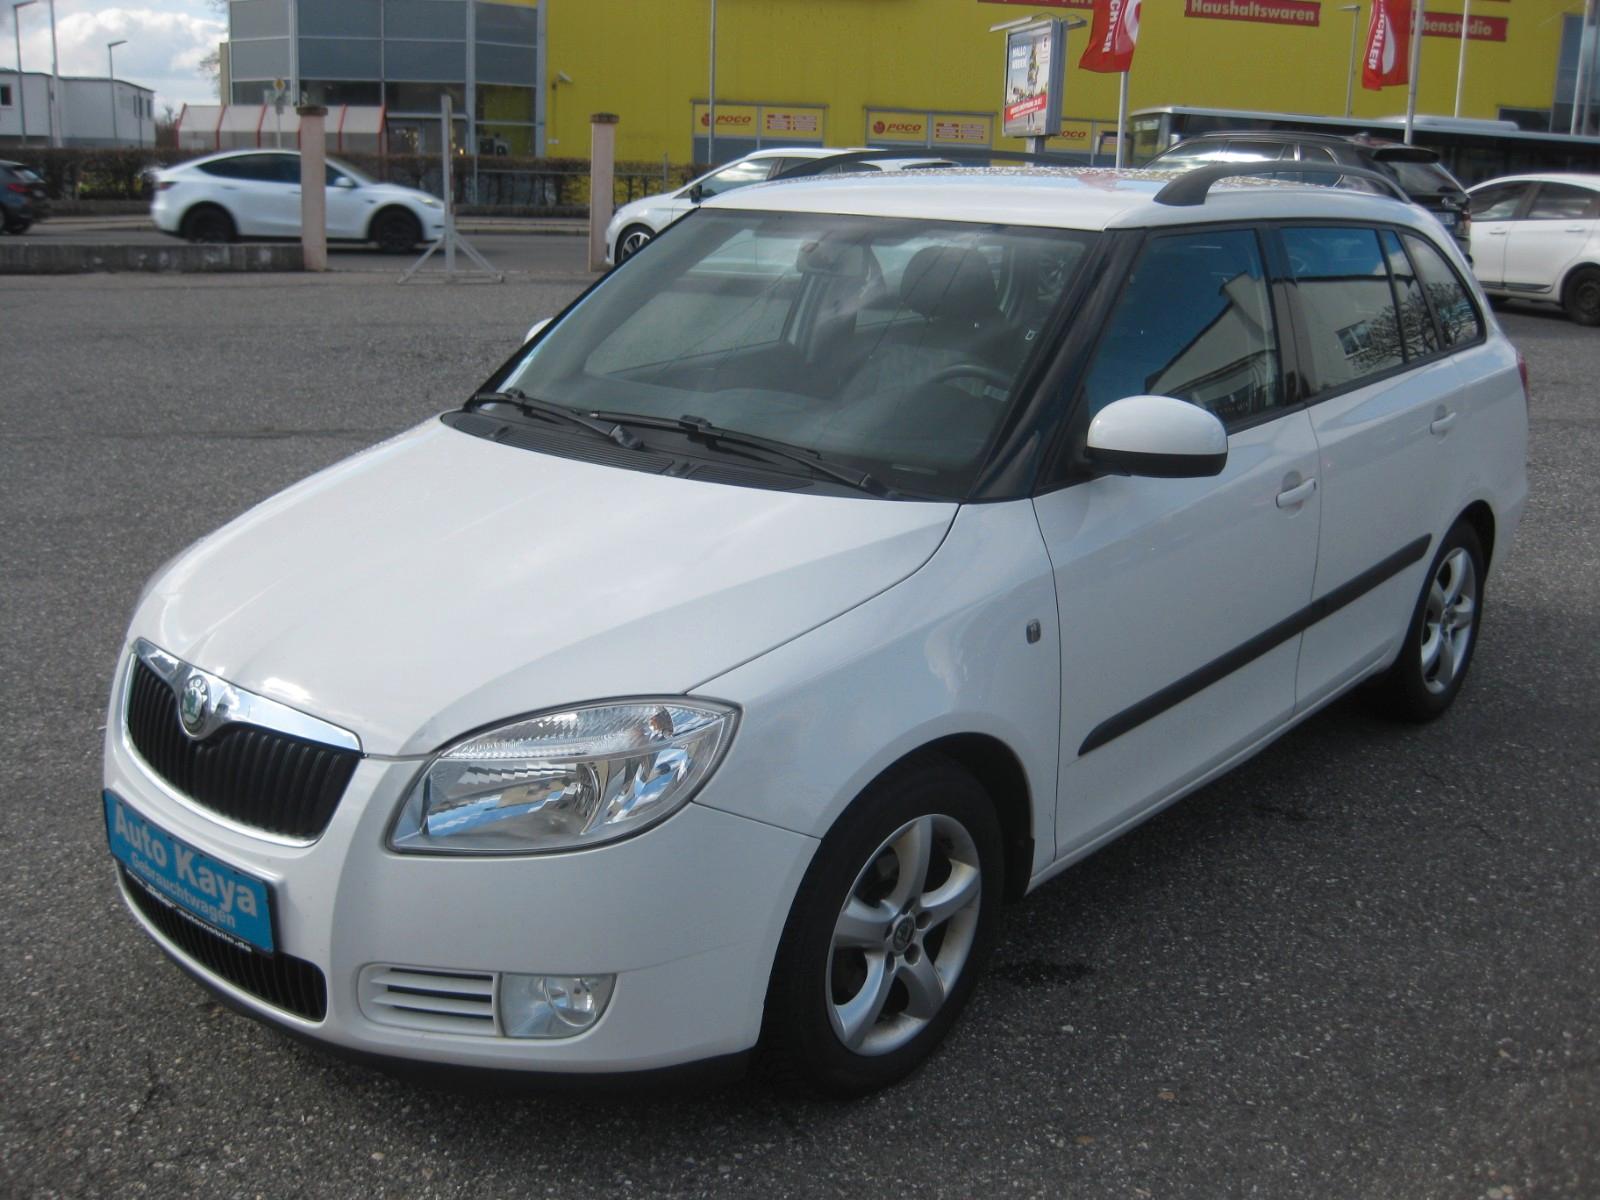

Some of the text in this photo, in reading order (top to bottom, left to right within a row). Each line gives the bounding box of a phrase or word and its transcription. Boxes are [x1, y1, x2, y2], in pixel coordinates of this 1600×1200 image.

[1190, 0, 1315, 21] Haushaltswaren
[715, 114, 752, 125] POCO
[886, 122, 922, 133] POCO
[1060, 129, 1088, 139] OCO
[114, 803, 258, 918] Auto Kaya
[130, 850, 237, 930] Gebrauchtwagen
